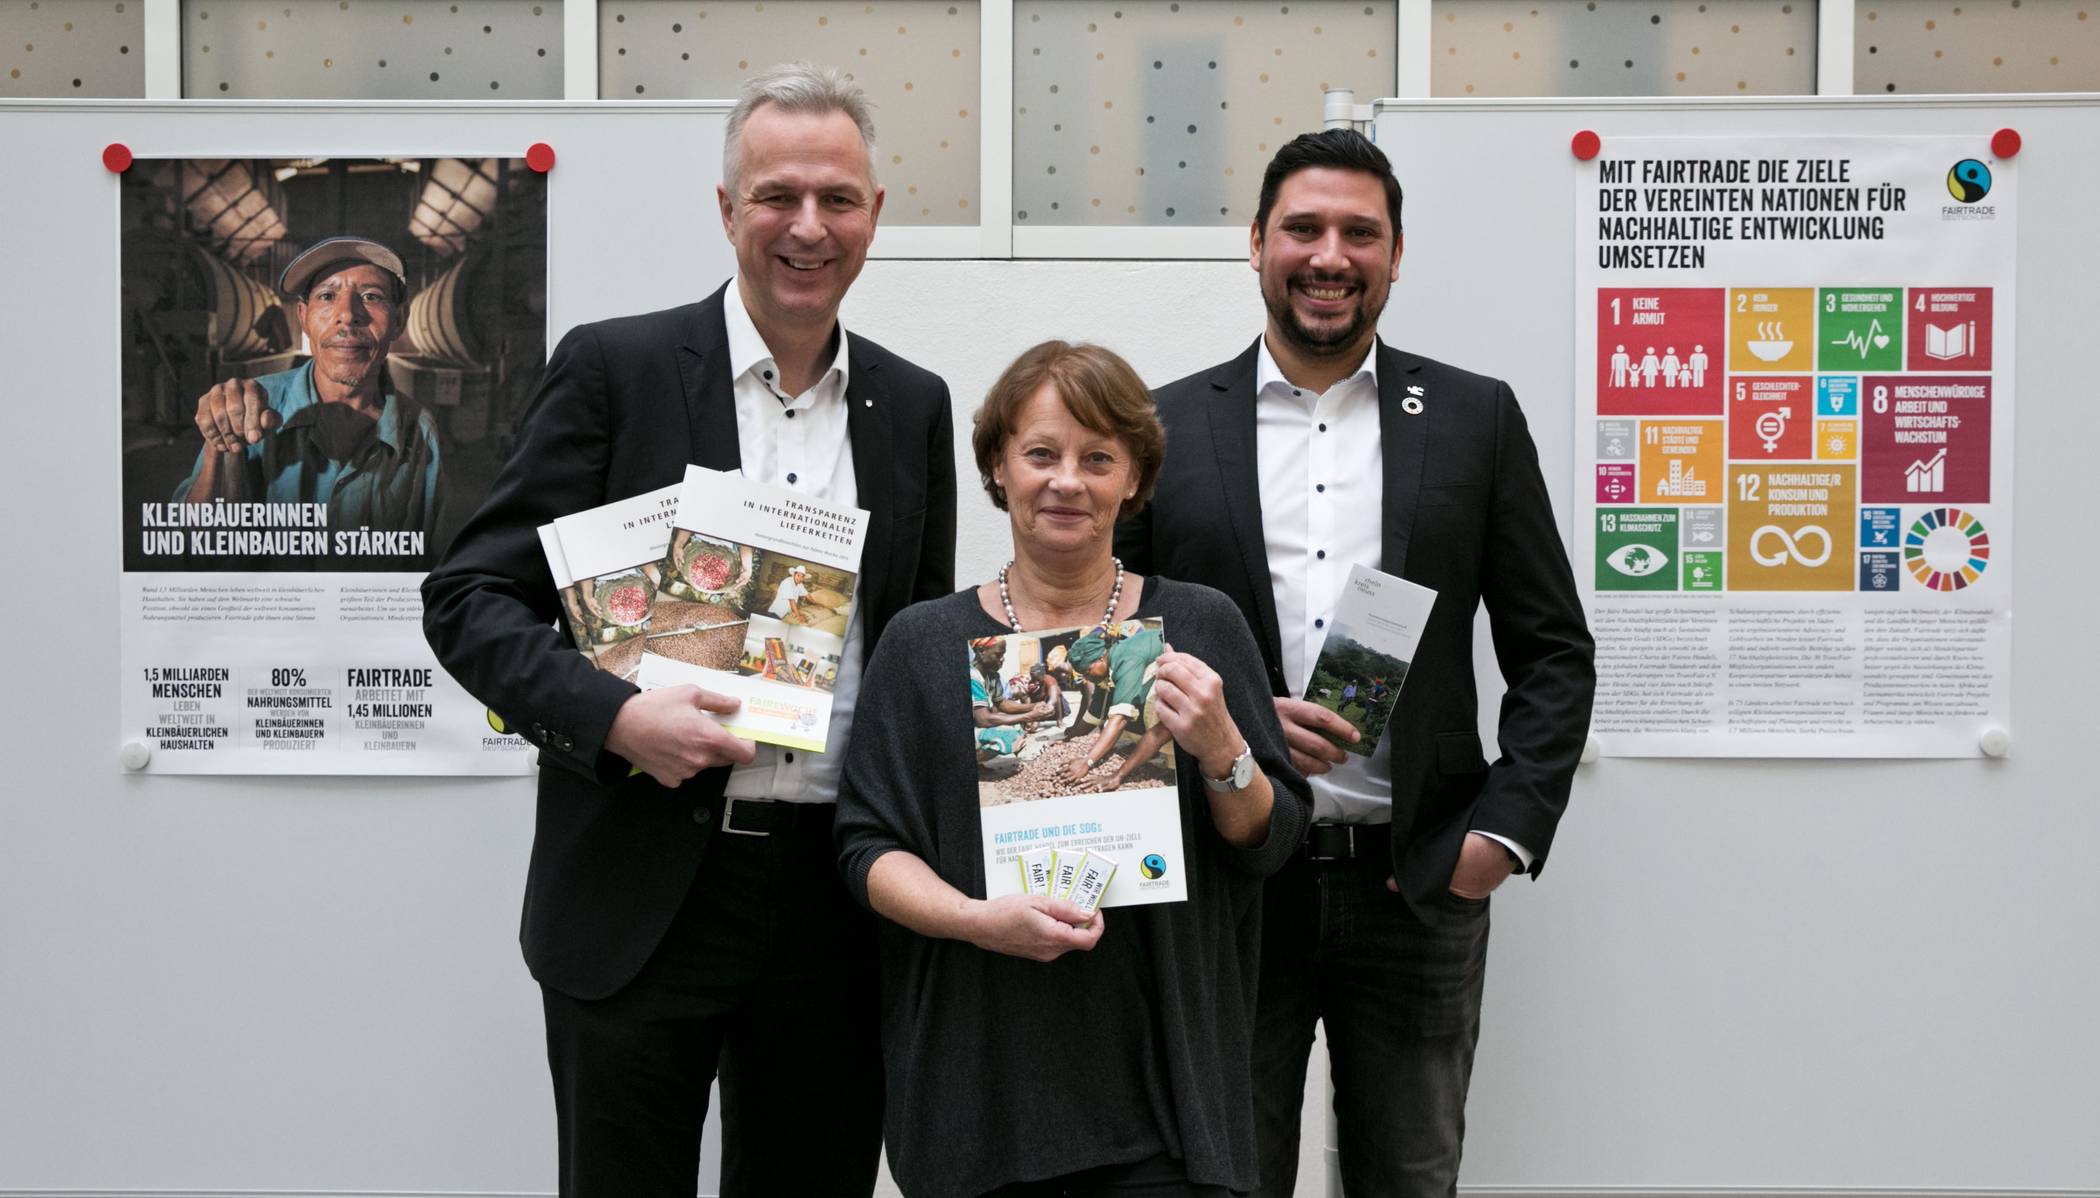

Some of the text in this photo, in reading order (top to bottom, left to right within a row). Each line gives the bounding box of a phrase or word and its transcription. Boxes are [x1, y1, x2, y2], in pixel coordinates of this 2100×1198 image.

[1600, 159, 1850, 183] MIT FAIRTRADE DIE ZIELE
[1599, 182, 1906, 212] DER VEREINTEN NATIONEN FÜR
[1942, 206, 1996, 215] FAIRTRADE
[1599, 216, 1884, 240] NACHHALTIGE ENTWICKLUNG
[1599, 245, 1705, 269] UMSETZEN
[1632, 297, 1660, 311] KEINE
[1737, 294, 1747, 313] 2
[1826, 293, 1836, 312] 3
[1915, 293, 1926, 312] 4
[1610, 298, 1621, 325] 1
[1632, 312, 1665, 325] ARMUT
[1736, 382, 1746, 401] 5
[1894, 384, 1986, 398] MENSCHENWÜRDIGE
[1873, 385, 1888, 414] 8
[1894, 401, 1948, 413] ARBEIT UND
[1894, 416, 1961, 428] WIRTSCHAFTS-
[1645, 426, 1658, 445] 11
[1894, 431, 1947, 443] WACHSTUM
[1737, 473, 1761, 502] 12
[1768, 473, 1842, 487] NACHHALTIGE/R
[659, 497, 679, 508] TRA
[1768, 489, 1829, 502] KONSUM UND
[142, 497, 328, 527] KLEINBÄUERINNEN
[785, 500, 857, 526] TRANSPARENZ
[1768, 503, 1828, 516] PRODUKTION
[623, 521, 634, 530] IN
[639, 509, 677, 525] INTERN
[743, 500, 855, 535] IN INTERNATIONALEN
[1600, 513, 1616, 532] 13
[142, 525, 425, 556] UND KLEINBAUERN STÄRKEN
[780, 521, 852, 545] LIEFERKETTEN
[144, 668, 229, 683] 1,5 MILLIARDEN
[272, 668, 307, 687] 80%
[347, 668, 433, 687] FAIRTRADE
[152, 683, 222, 698] MENSCHEN
[355, 689, 425, 701] ARBEITET MIT
[173, 700, 201, 712] LEBEN
[247, 696, 332, 708] NAHRUNGSMITTEL
[347, 703, 432, 719] 1,45 MILLIONEN
[159, 714, 215, 725] WELTWEIT IN
[255, 717, 325, 728] KLEINBÄUERINNEN
[146, 725, 228, 738] KLEINBÄUERLICHEN
[255, 729, 325, 738] UND KLEINBAUERN
[382, 730, 399, 739] UND
[160, 739, 215, 750] HAUSHALTEN
[263, 740, 316, 750] PRODUZIERT
[363, 741, 417, 751] KLEINBAUERN
[994, 822, 1103, 844] FAIRTRADE UND DIE SDGs
